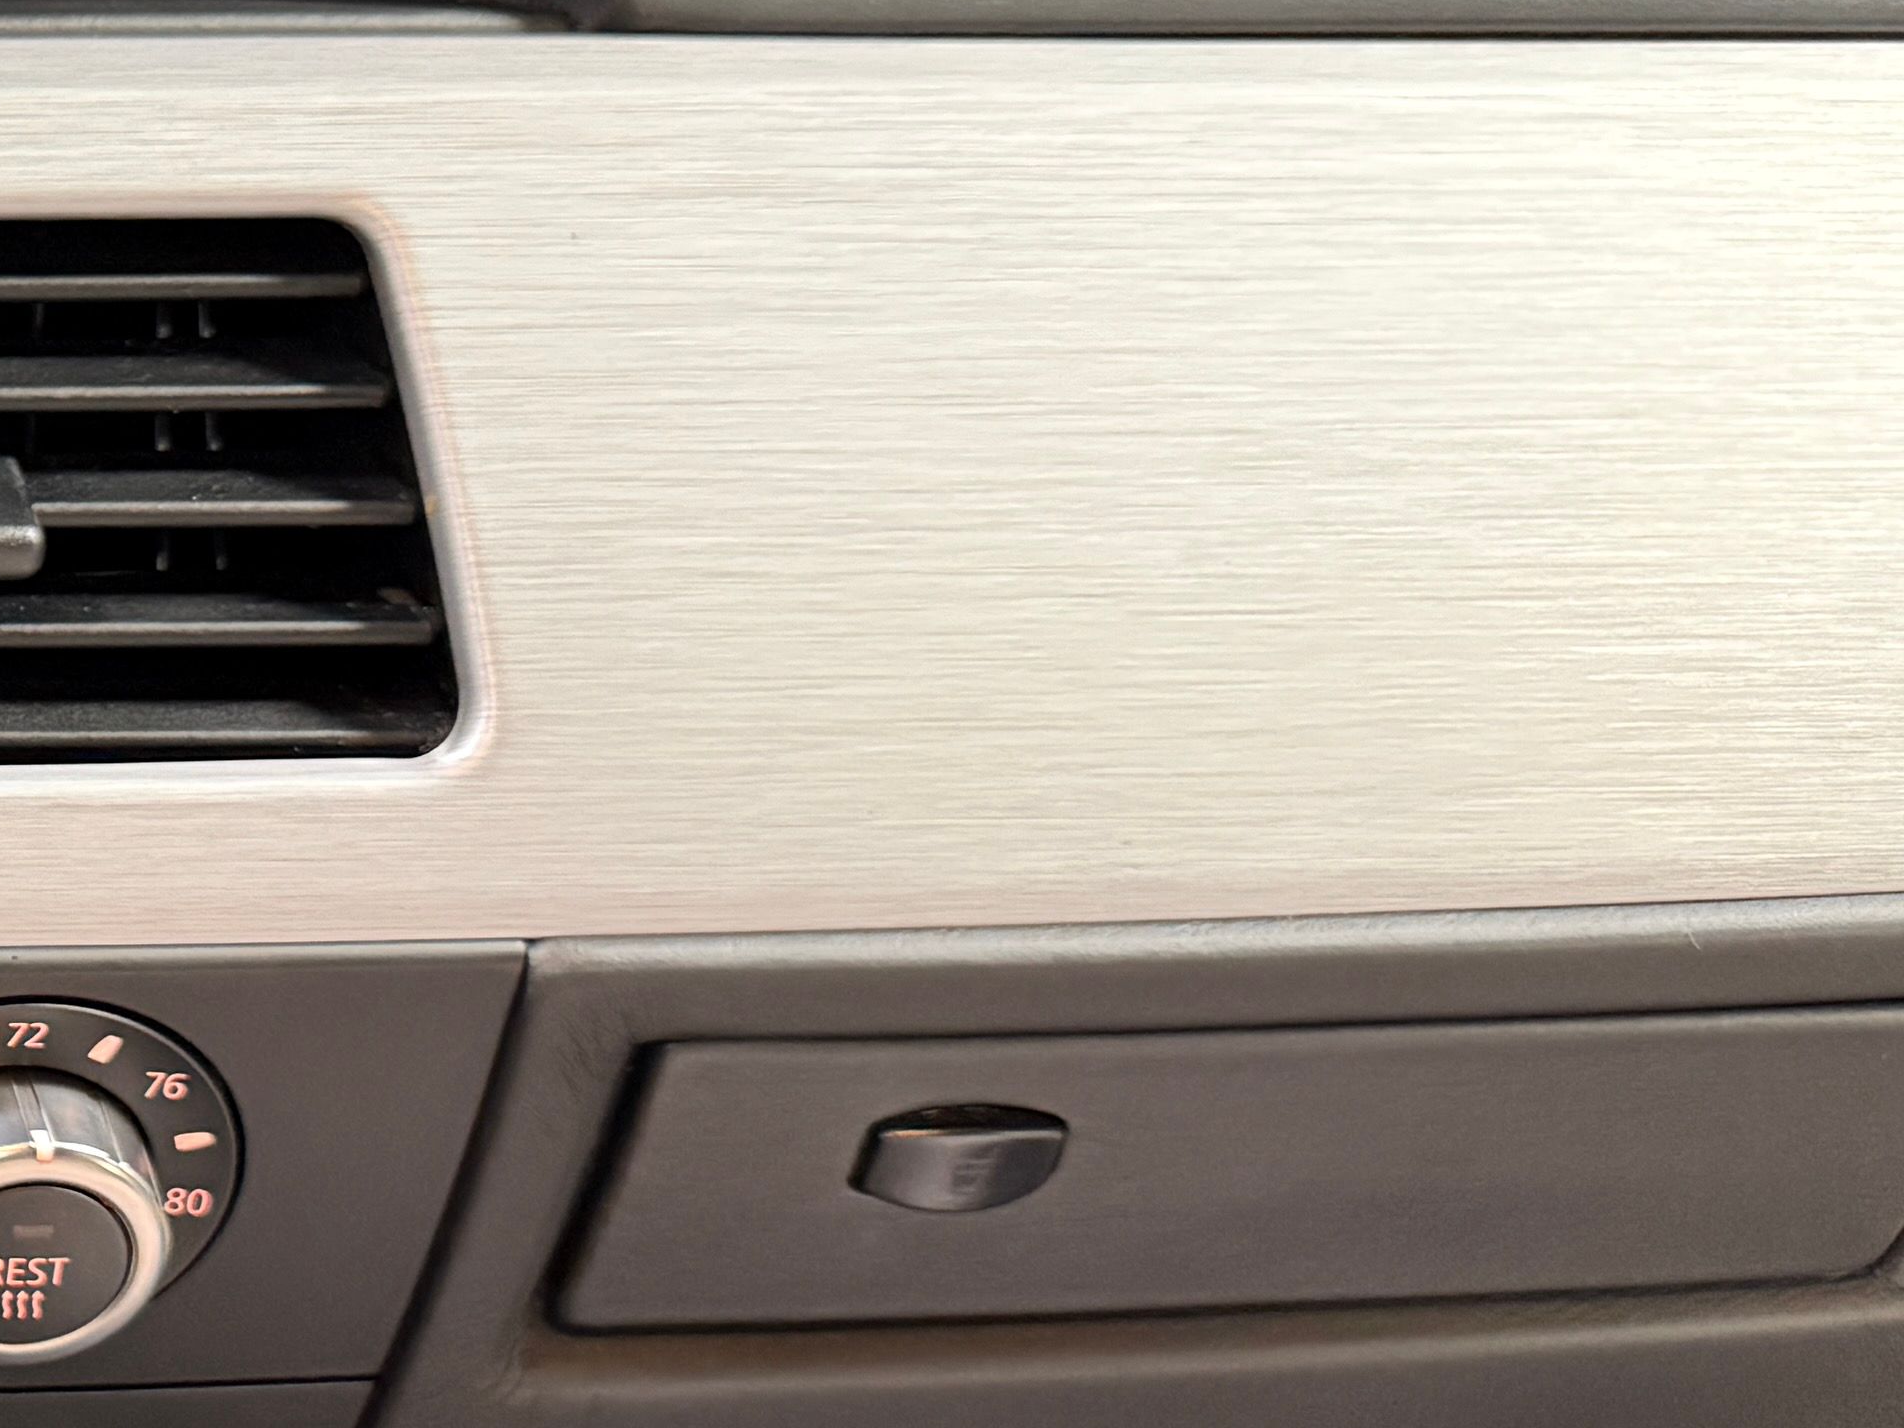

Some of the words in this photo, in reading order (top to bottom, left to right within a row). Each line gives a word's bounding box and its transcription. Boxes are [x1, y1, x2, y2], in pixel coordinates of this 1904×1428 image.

[7, 1022, 49, 1049] 72
[145, 1071, 191, 1100] 76
[164, 1188, 213, 1217] 80
